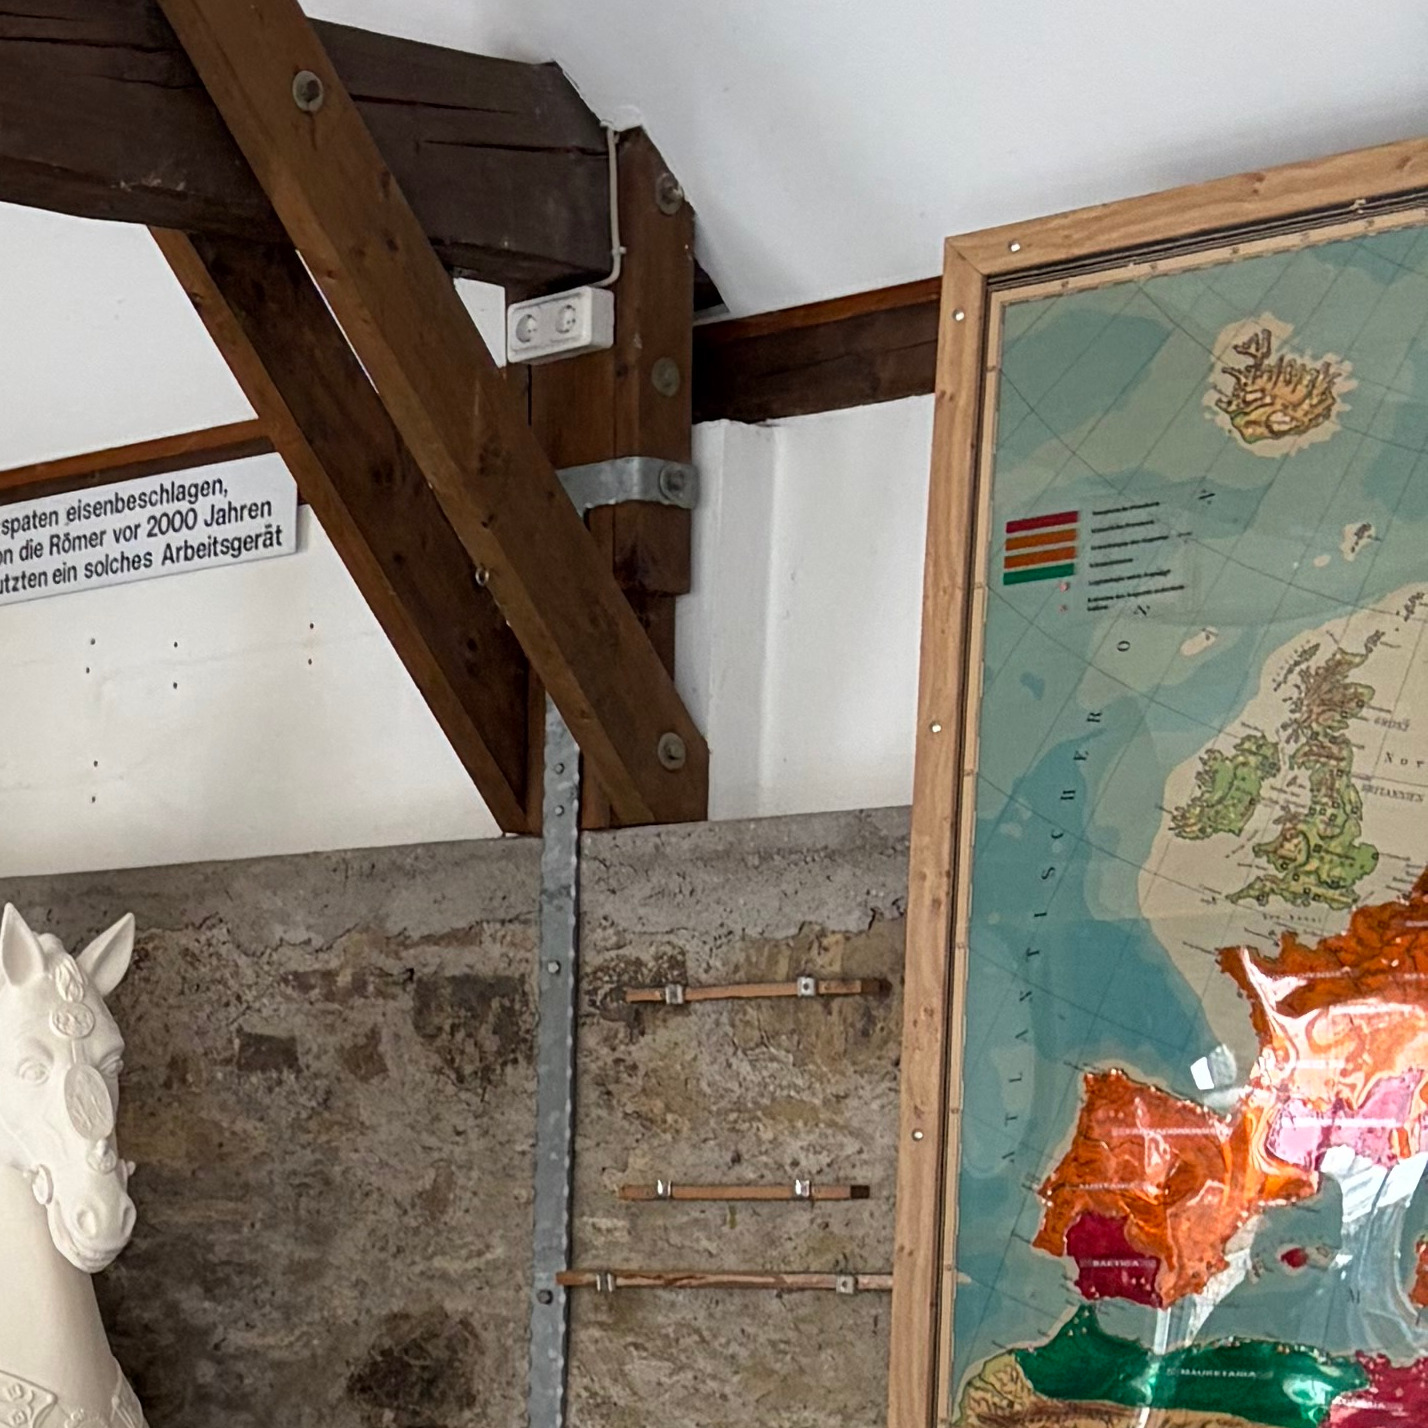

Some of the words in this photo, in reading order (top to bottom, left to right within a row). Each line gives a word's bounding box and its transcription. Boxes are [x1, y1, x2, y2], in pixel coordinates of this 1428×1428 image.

[65, 477, 228, 525] eisenbeschlagen,
[19, 536, 44, 564] die
[49, 528, 107, 558] Römer
[113, 523, 142, 545] vor
[146, 509, 198, 538] 2000
[204, 500, 273, 528] Jahren
[52, 561, 78, 585] ein
[83, 548, 153, 580] solches
[161, 524, 284, 568] Arbeitsgerät
